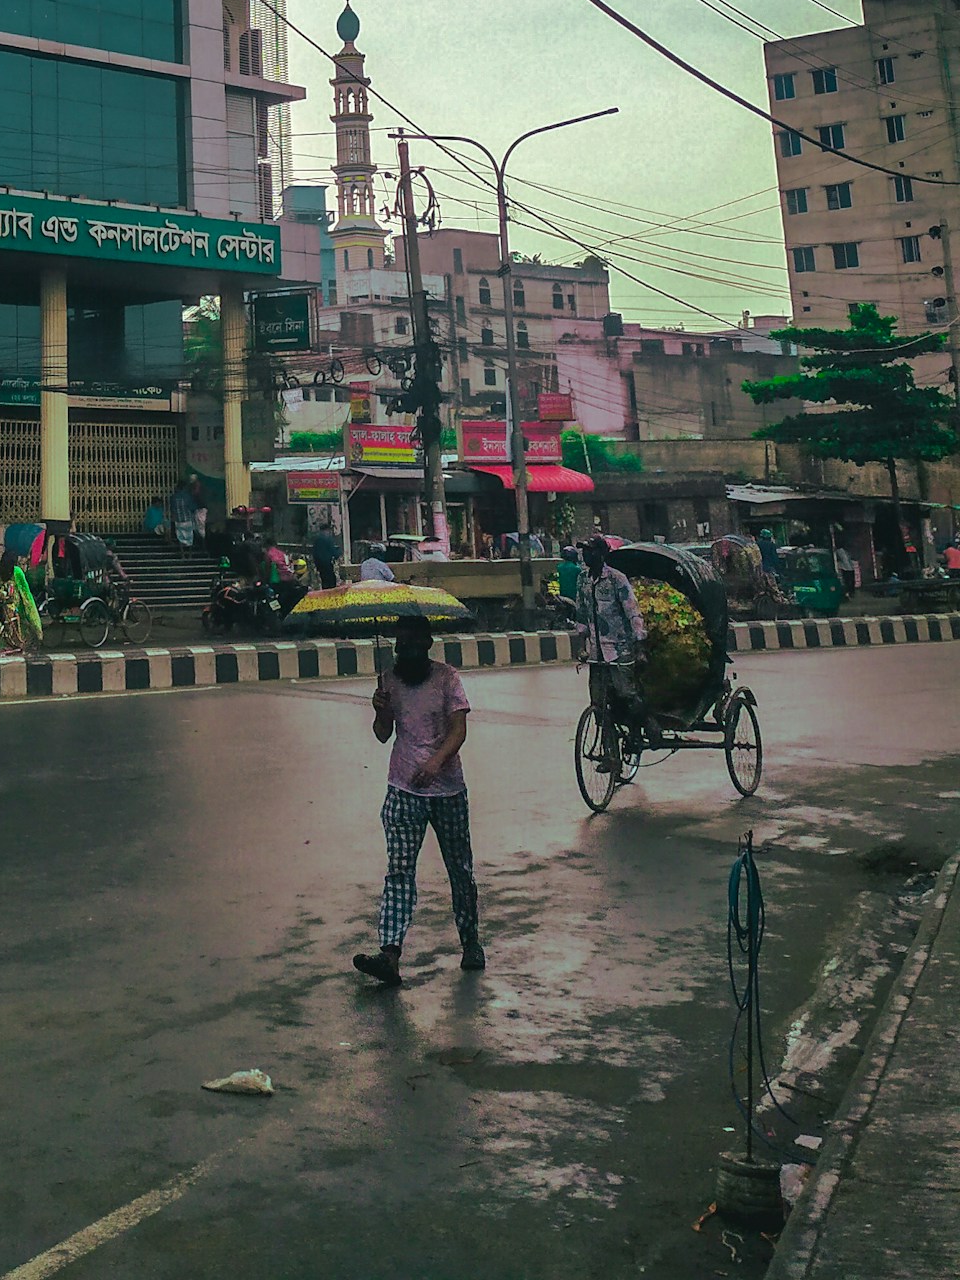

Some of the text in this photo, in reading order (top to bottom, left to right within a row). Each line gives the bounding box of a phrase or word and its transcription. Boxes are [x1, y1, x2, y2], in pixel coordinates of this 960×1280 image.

[41, 215, 79, 244] এন্ড
[87, 219, 210, 257] কনসালটেশন
[217, 228, 275, 264] সেন্টার
[284, 317, 304, 333] সিনা
